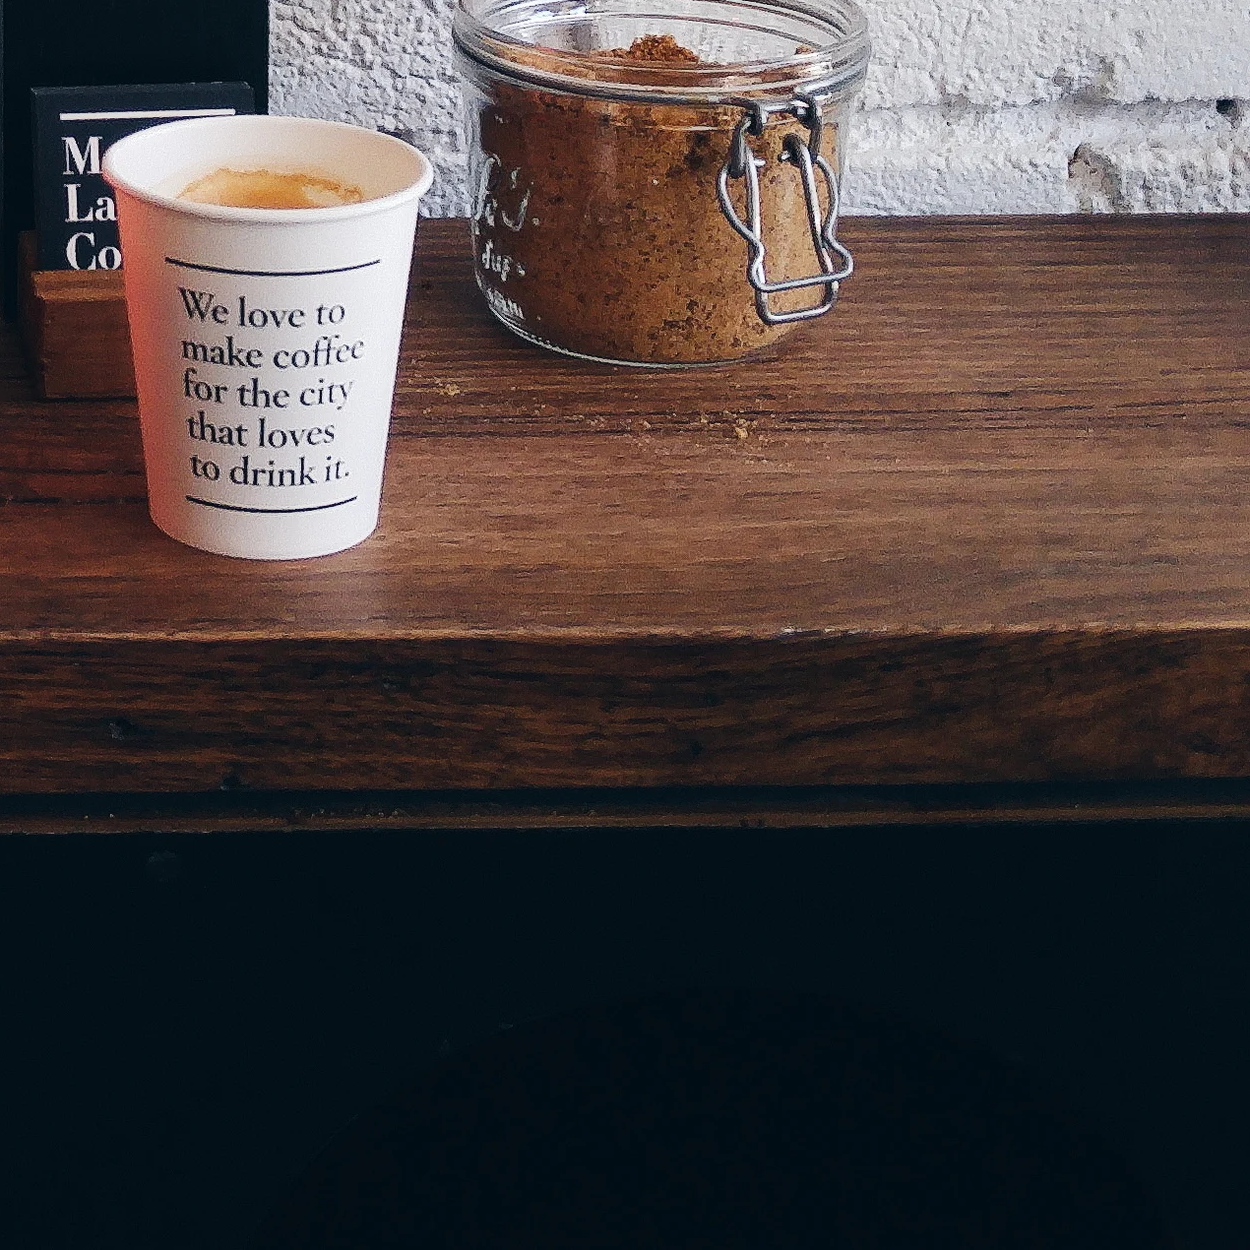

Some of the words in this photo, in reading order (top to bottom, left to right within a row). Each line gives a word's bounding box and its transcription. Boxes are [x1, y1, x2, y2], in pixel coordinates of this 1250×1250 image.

[61, 135, 103, 175] M
[63, 183, 117, 223] La
[65, 231, 122, 270] Co
[177, 286, 229, 324] We
[238, 295, 306, 329] love
[316, 304, 346, 326] to
[181, 336, 264, 368] make
[273, 335, 365, 369] coffee
[183, 367, 228, 403] for
[237, 377, 290, 409] the
[299, 378, 355, 410] city
[186, 411, 248, 447] that
[258, 417, 336, 448] loves
[190, 454, 220, 481] to
[229, 455, 318, 488] drink
[324, 455, 350, 482] it.
